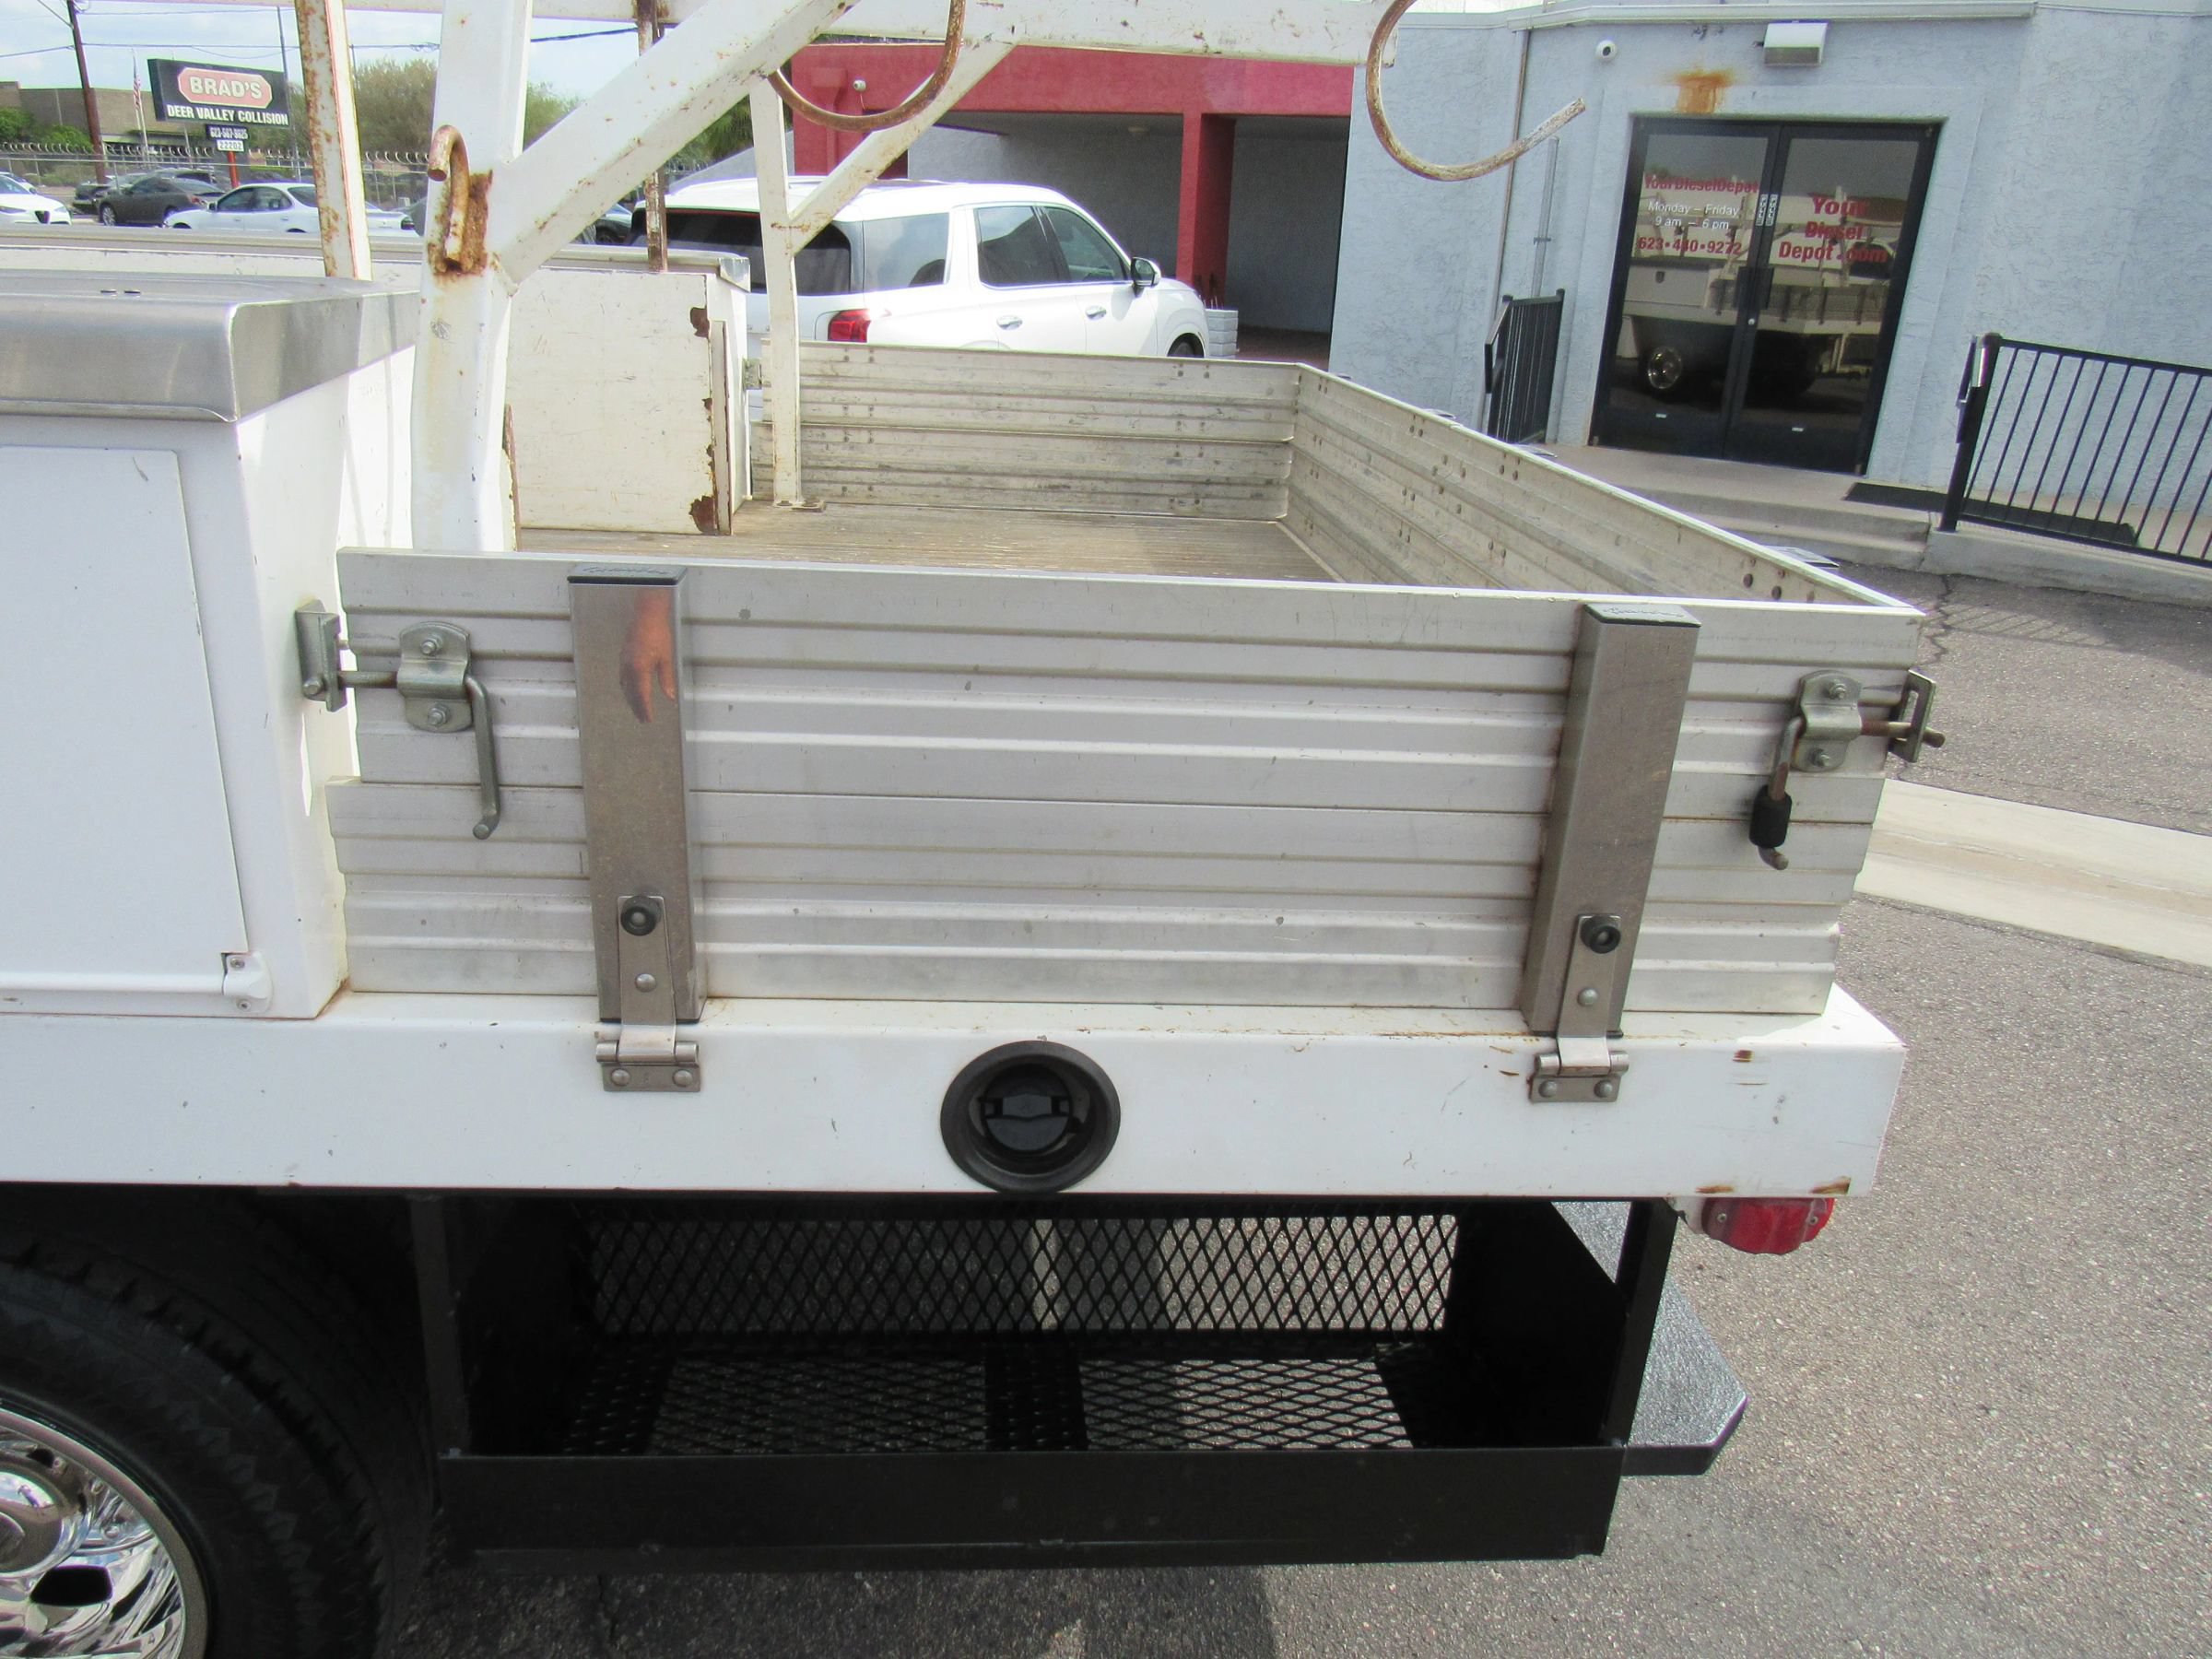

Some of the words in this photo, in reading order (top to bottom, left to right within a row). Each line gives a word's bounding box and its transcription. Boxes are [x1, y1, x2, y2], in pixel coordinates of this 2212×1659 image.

[189, 76, 263, 100] BRAD'S
[166, 104, 194, 119] DEER
[195, 107, 235, 122] VALLEY
[238, 110, 289, 125] COLLISION
[1648, 200, 1690, 215] Monday
[1705, 204, 1740, 217] Friday
[1655, 216, 1662, 226] 9
[1665, 218, 1682, 227] am
[1702, 218, 1710, 229] 6
[1712, 221, 1729, 230] pm
[1805, 221, 1865, 241] Diesel
